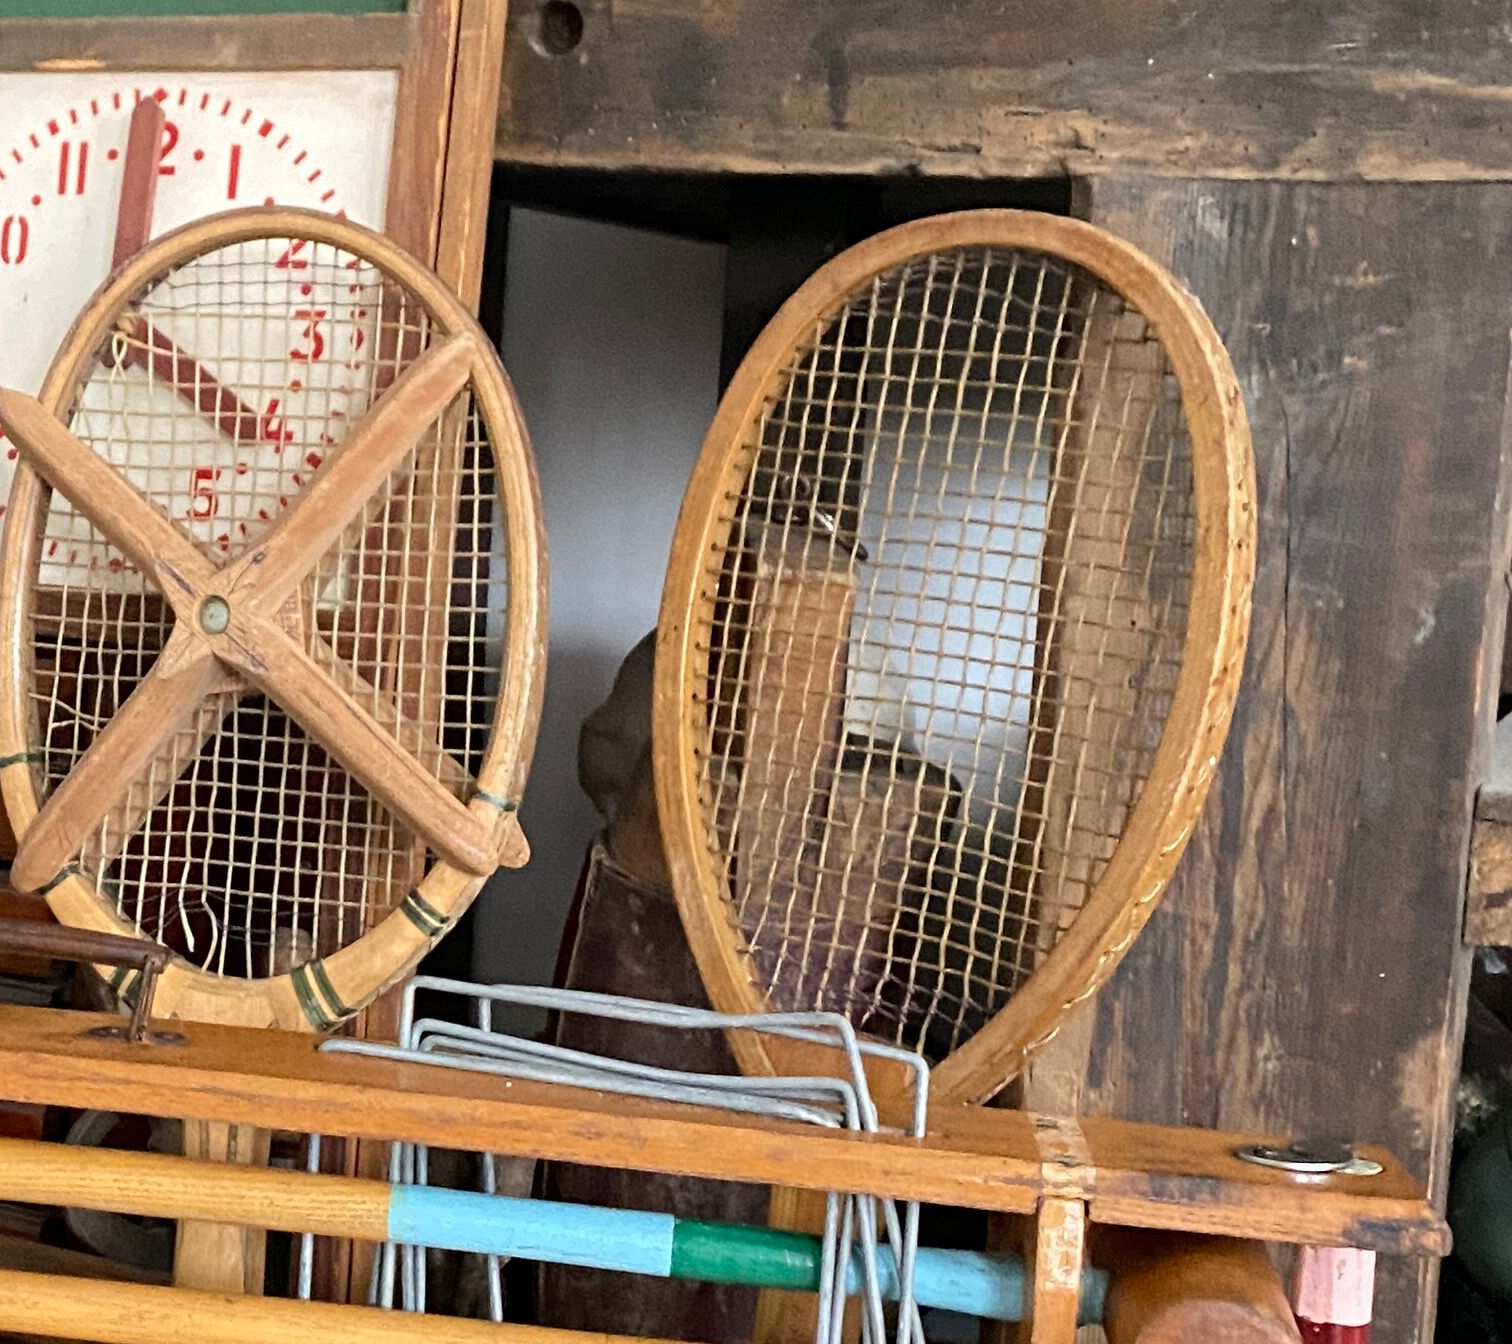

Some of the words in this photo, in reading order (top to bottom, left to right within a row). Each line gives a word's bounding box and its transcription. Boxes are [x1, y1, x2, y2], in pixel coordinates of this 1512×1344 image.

[57, 141, 89, 196] 11
[226, 143, 242, 200] 1
[289, 310, 327, 361] 3
[262, 398, 295, 454] 4
[186, 467, 222, 520] 5
